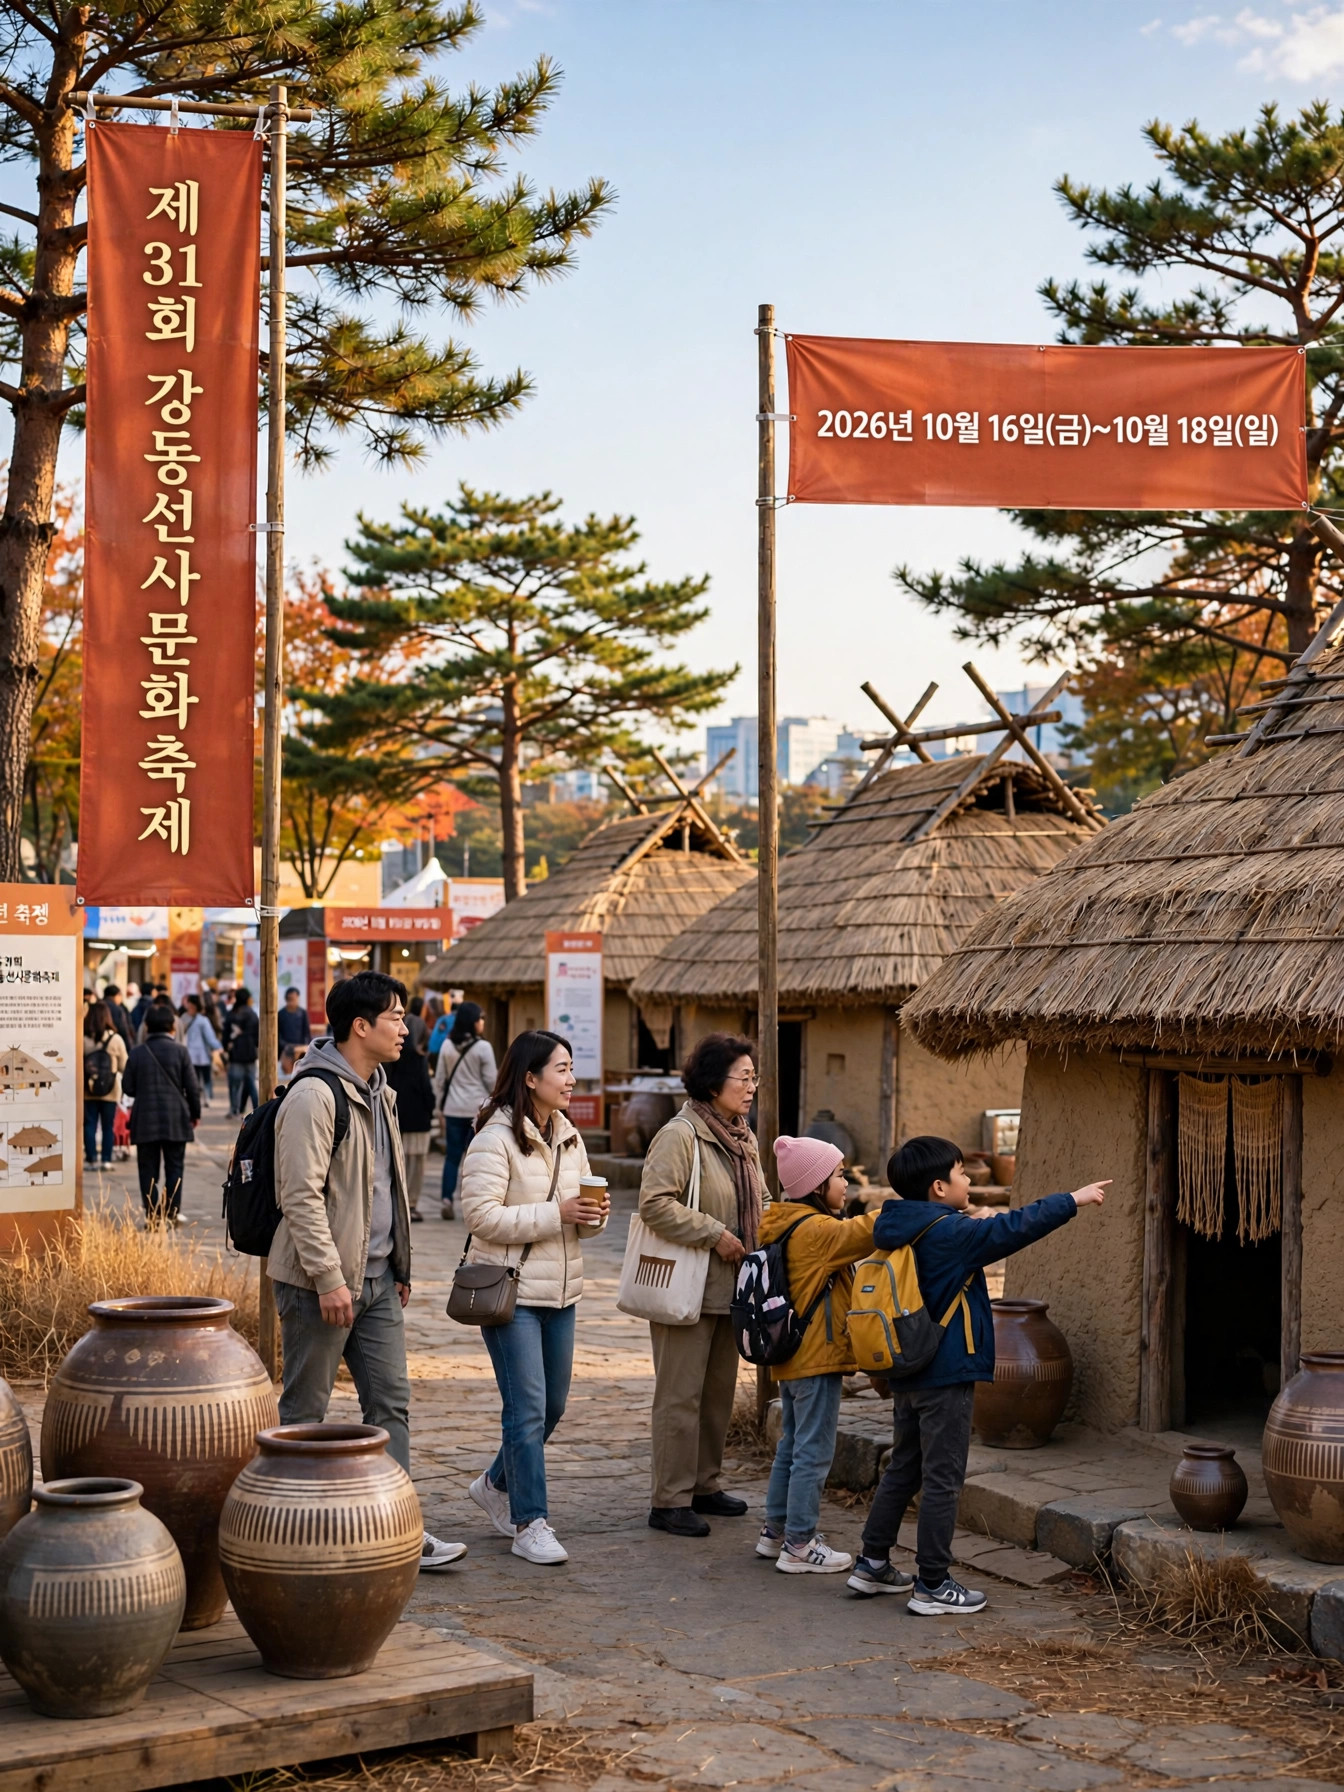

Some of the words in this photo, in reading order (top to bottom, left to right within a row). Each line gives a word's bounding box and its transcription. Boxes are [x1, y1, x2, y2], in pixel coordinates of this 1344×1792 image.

[142, 179, 203, 353] 제31회
[817, 409, 913, 442] 2026년
[922, 411, 980, 444] 10월
[988, 413, 1169, 447] 16일(금)~10월
[1177, 414, 1279, 448] 18일(일)
[137, 368, 204, 856] 강동선사문화축제
